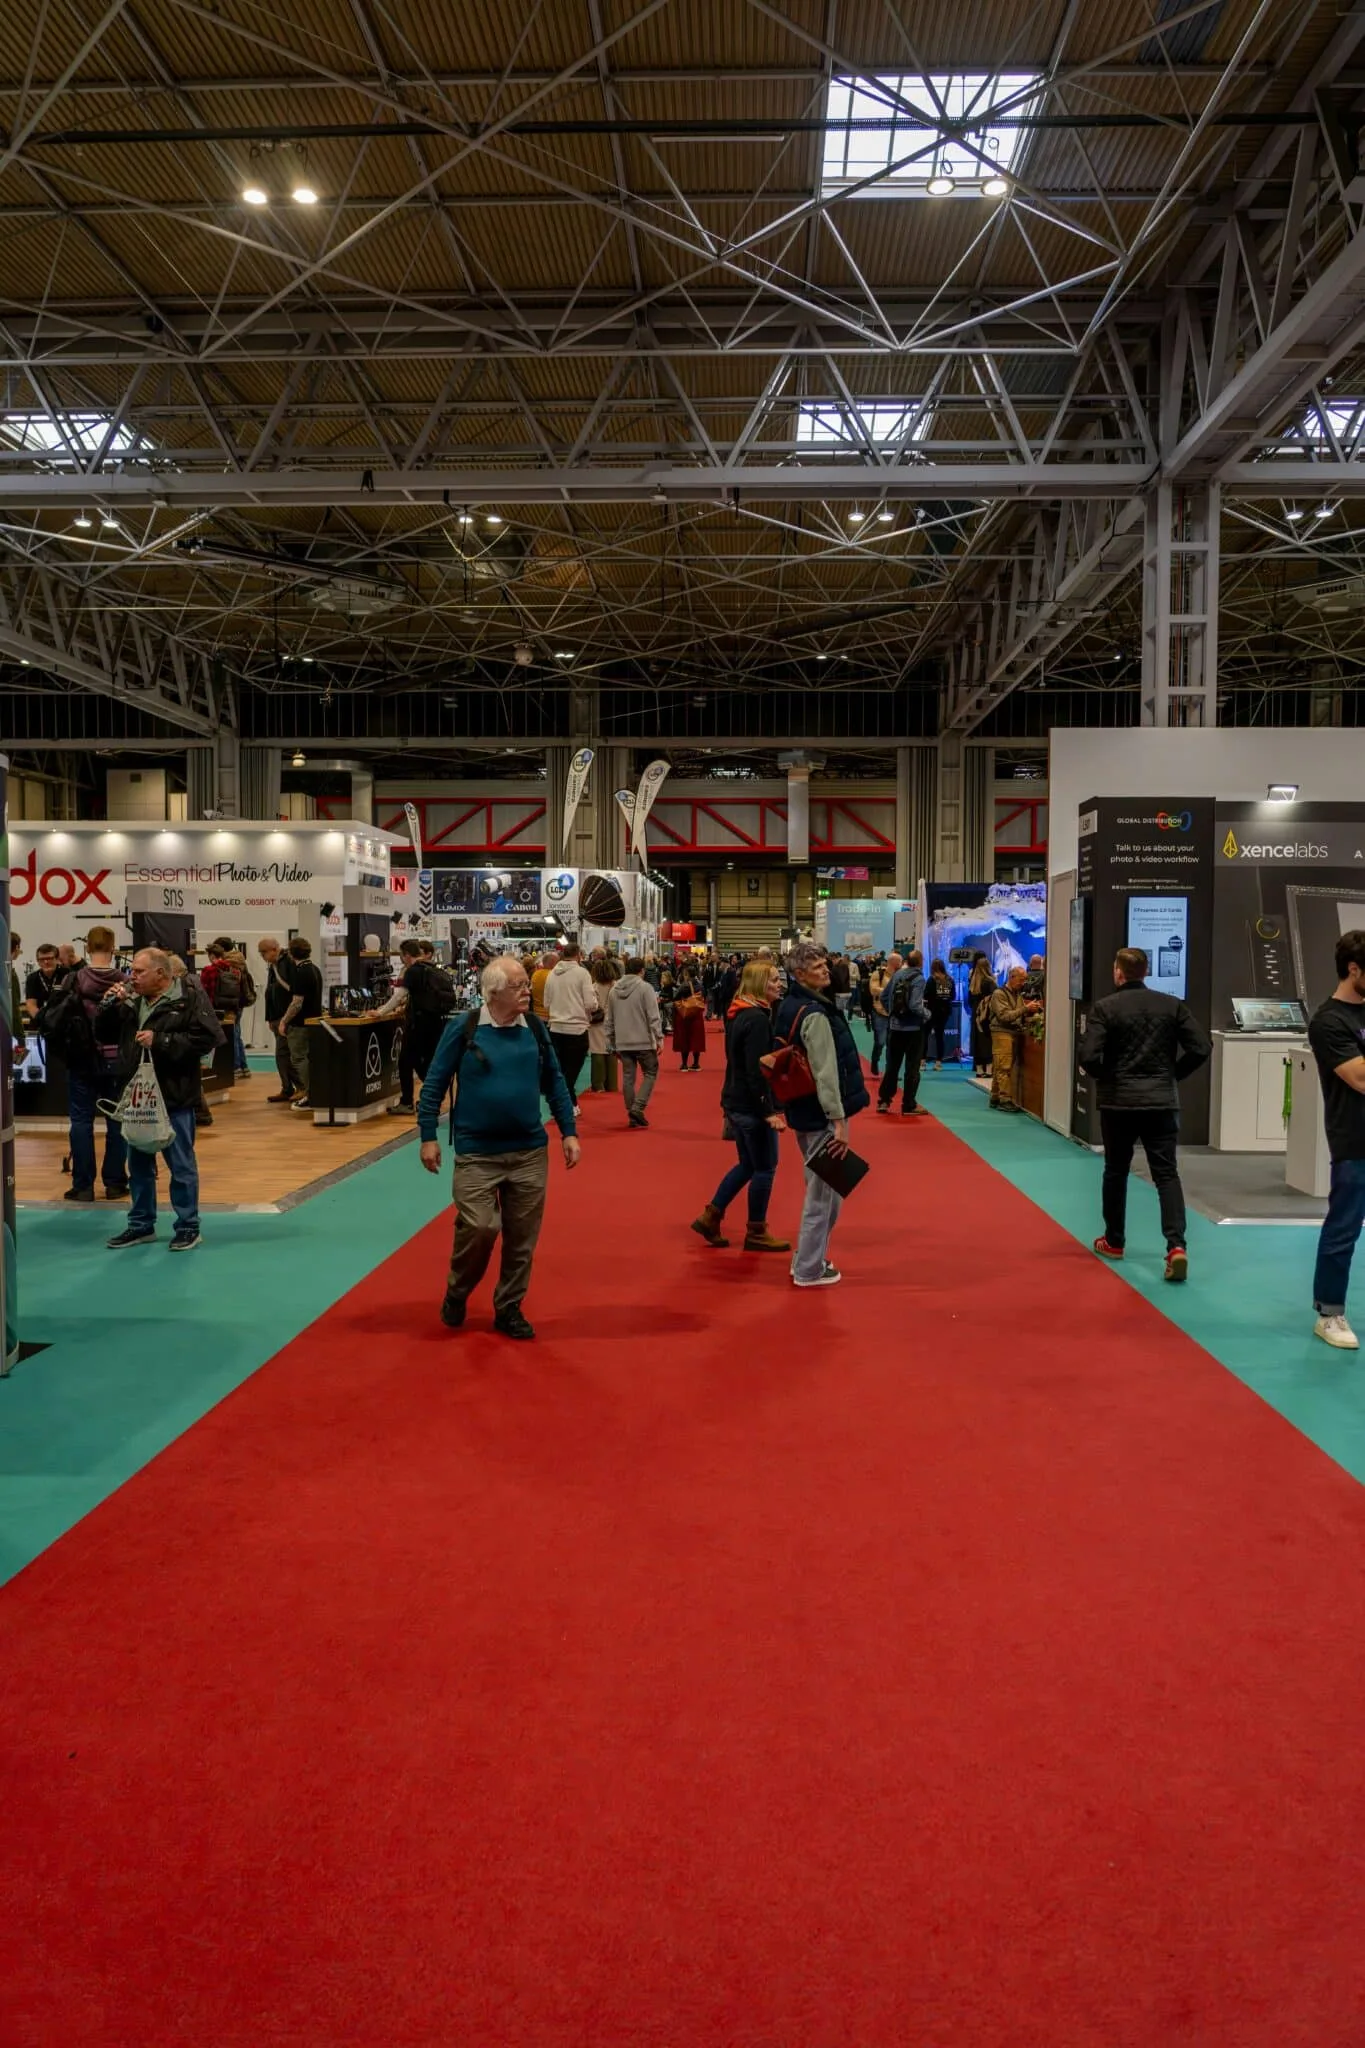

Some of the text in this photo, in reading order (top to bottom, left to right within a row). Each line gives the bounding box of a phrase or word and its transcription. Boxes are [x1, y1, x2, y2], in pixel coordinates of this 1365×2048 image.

[1116, 844, 1131, 852] Talk
[1153, 844, 1175, 852] about
[1177, 846, 1194, 855] your
[1240, 842, 1329, 858] xencelabs
[1110, 855, 1134, 864] photo
[1141, 855, 1162, 863] video
[1164, 855, 1199, 863] workflow
[505, 903, 538, 911] Canon
